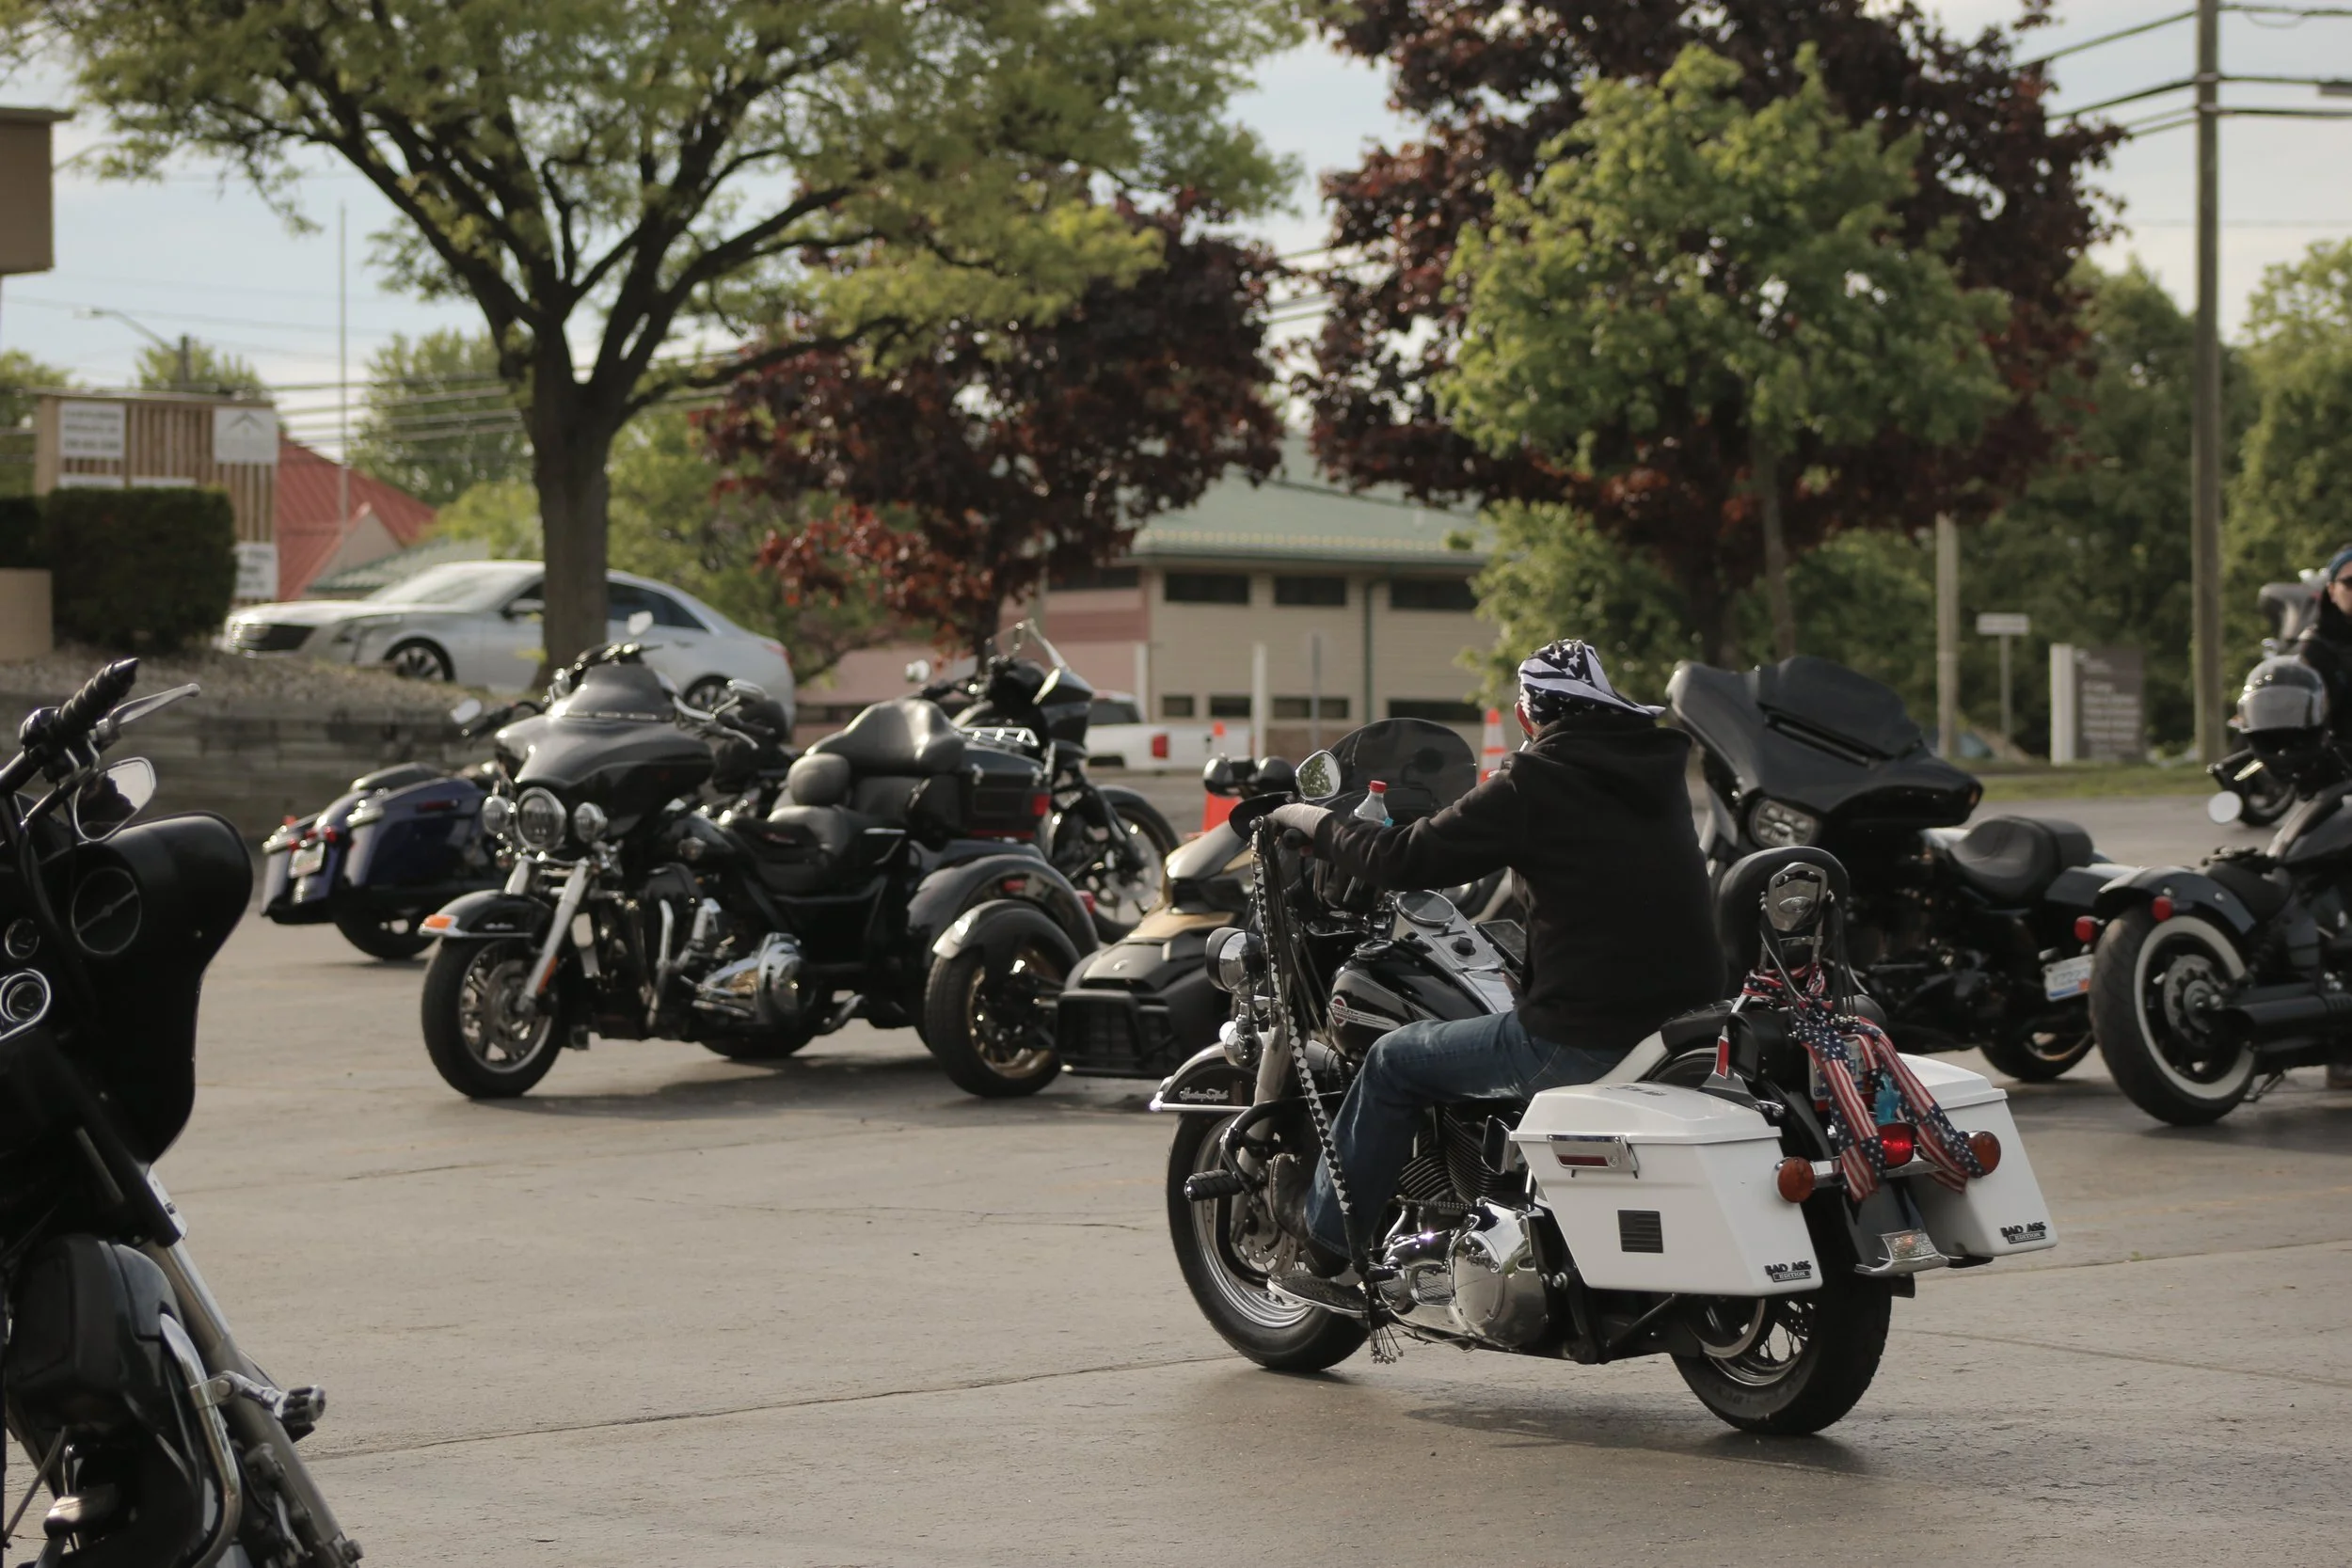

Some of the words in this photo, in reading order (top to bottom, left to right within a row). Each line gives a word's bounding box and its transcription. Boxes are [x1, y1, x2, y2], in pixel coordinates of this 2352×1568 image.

[2000, 1226, 2024, 1237] BAD
[2026, 1222, 2046, 1232] ASS
[1764, 1263, 1788, 1275] BAD
[1791, 1260, 1812, 1272] ASS
[1777, 1271, 1807, 1280] EDITION
